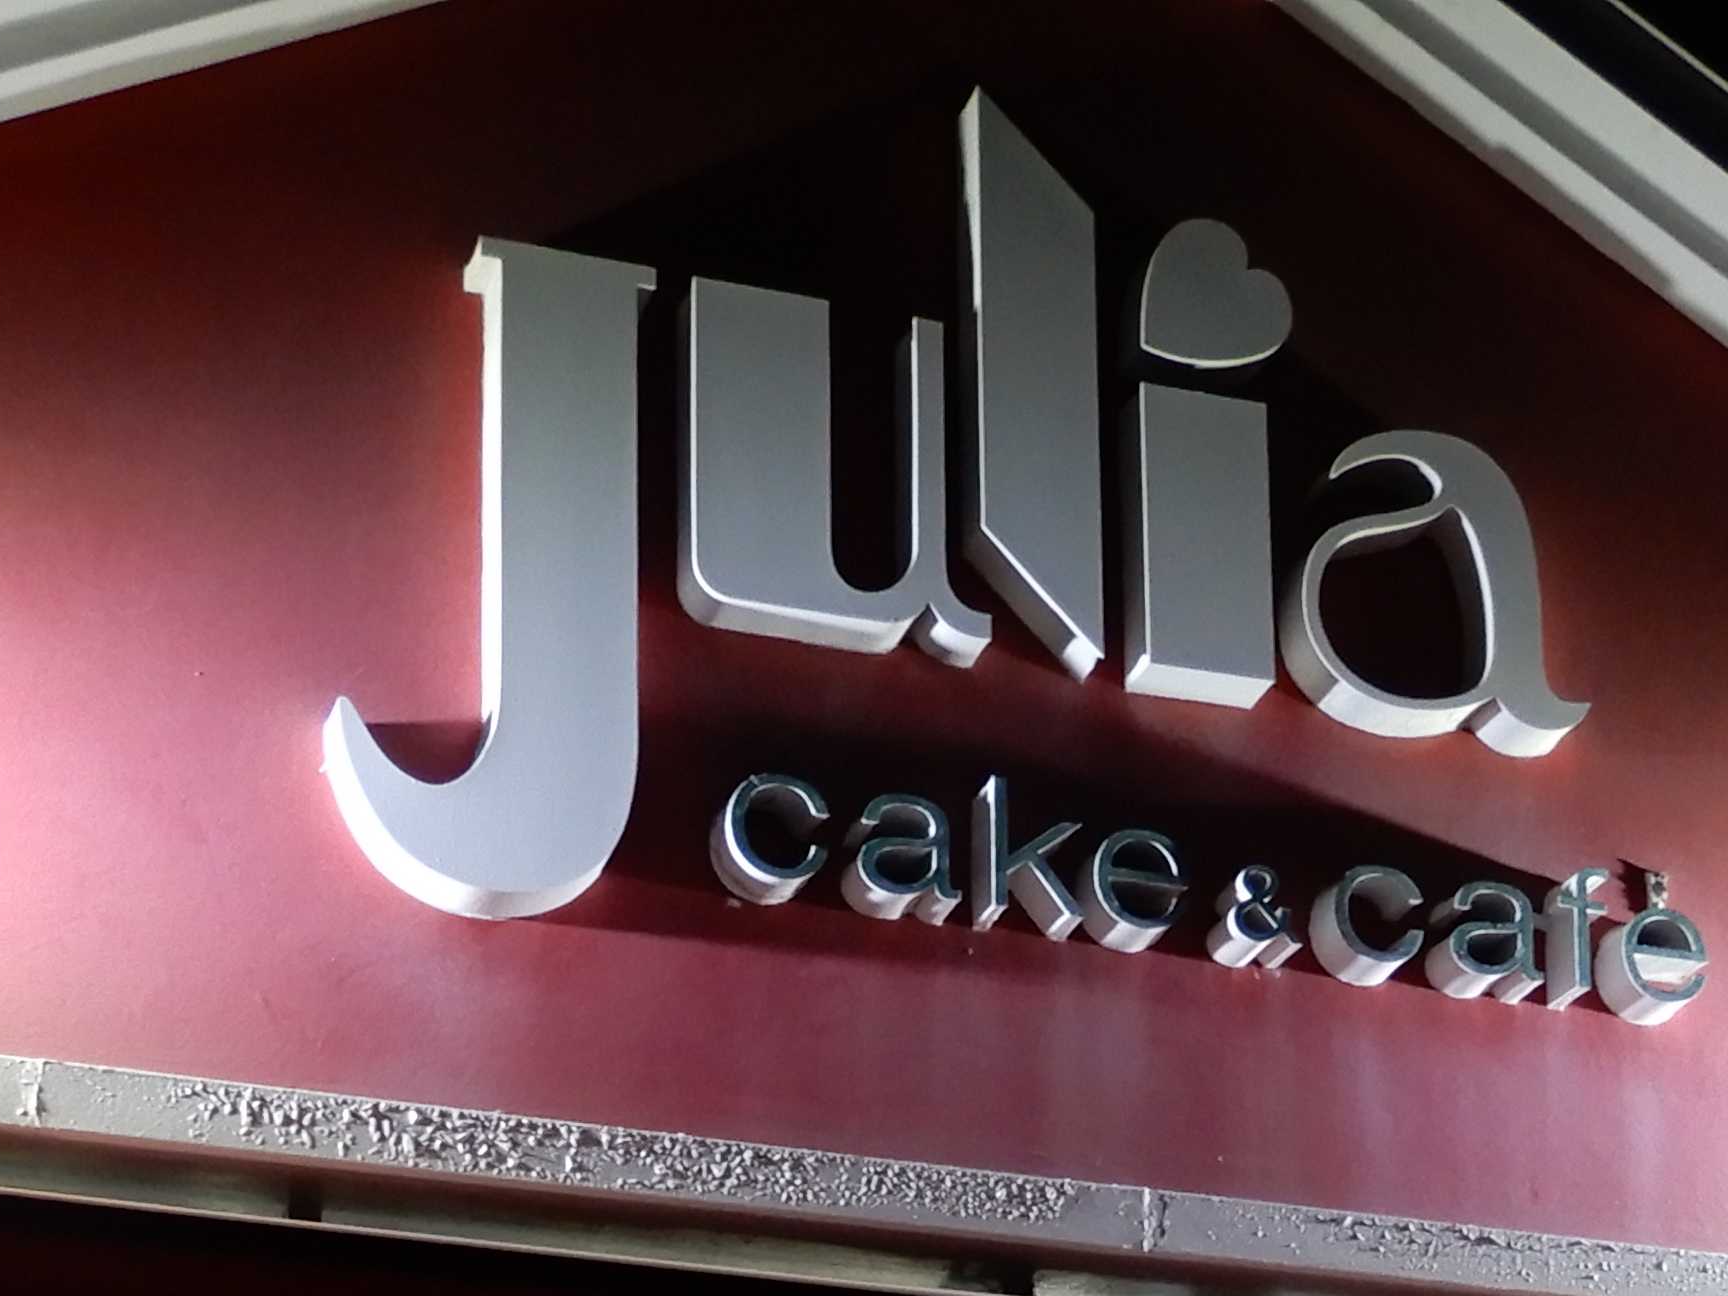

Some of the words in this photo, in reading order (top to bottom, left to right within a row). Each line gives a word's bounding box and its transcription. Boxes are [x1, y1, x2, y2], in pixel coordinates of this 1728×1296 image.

[320, 86, 1591, 920] Julia
[709, 774, 1190, 955] cake
[1208, 866, 1300, 968] &
